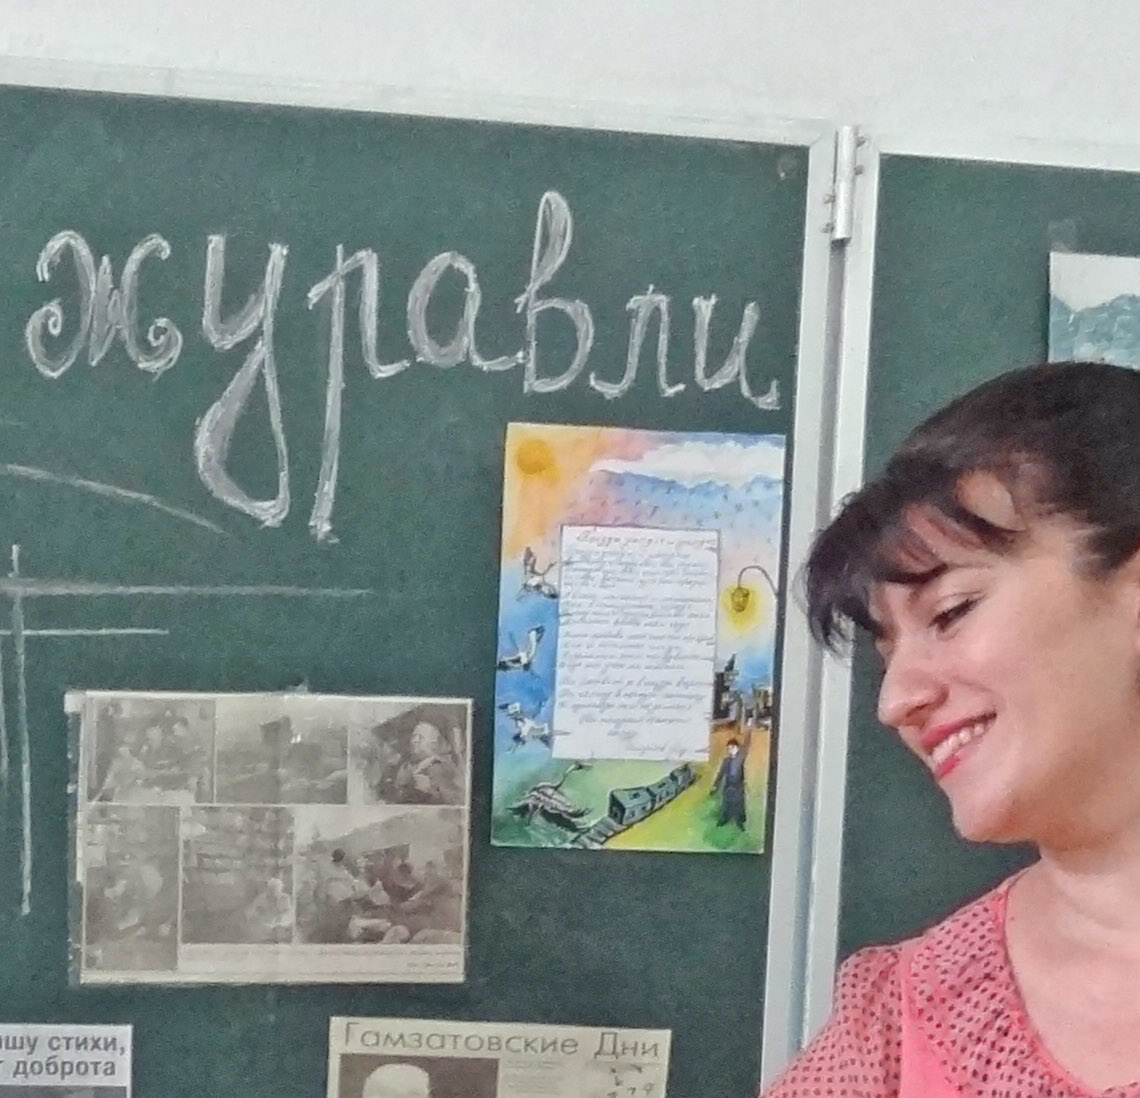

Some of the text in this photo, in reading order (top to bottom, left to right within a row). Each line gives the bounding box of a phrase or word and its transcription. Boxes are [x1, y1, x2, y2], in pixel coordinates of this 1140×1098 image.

[25, 191, 781, 542] журавли
[47, 1036, 125, 1056] стихи,
[344, 1022, 660, 1060] Гамзатовские Дни
[12, 1055, 116, 1080] доброта
